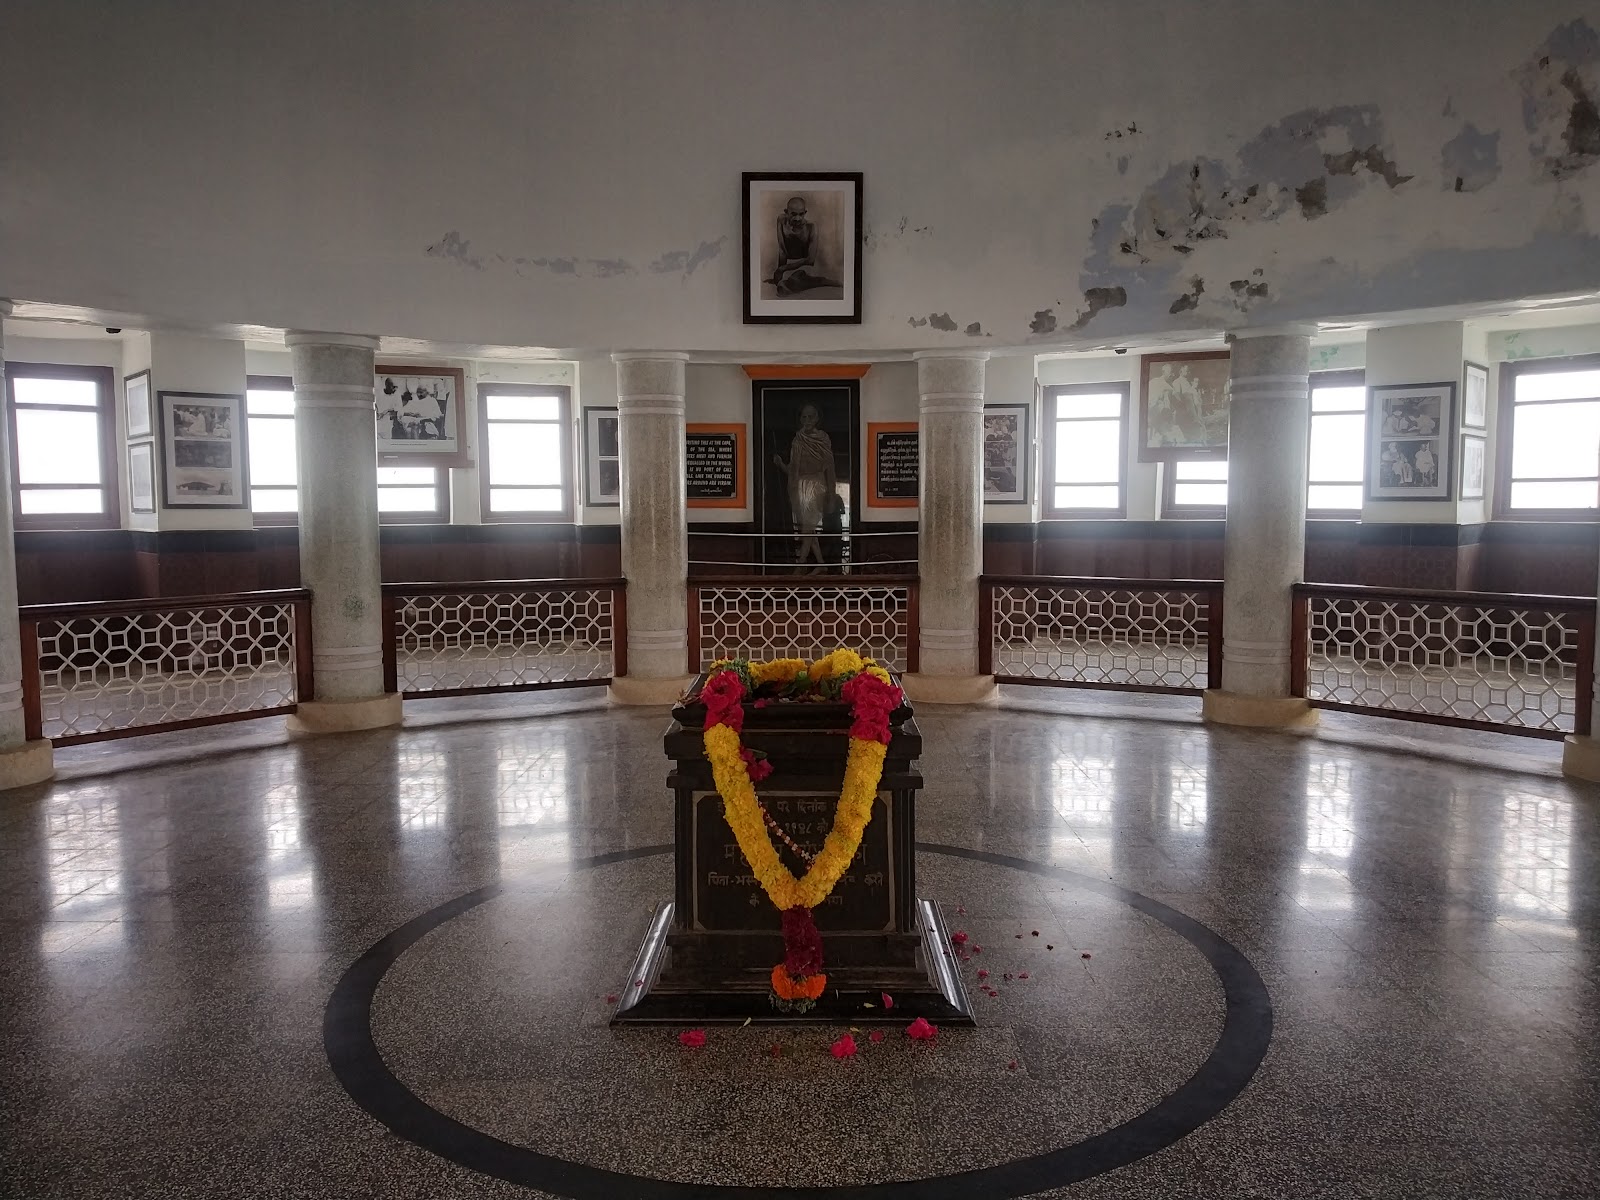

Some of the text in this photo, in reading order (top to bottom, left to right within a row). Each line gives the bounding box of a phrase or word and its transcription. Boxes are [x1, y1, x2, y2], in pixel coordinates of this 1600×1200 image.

[776, 800, 790, 812] पर
[816, 818, 829, 834] को
[708, 871, 759, 886] चिता-भस्
